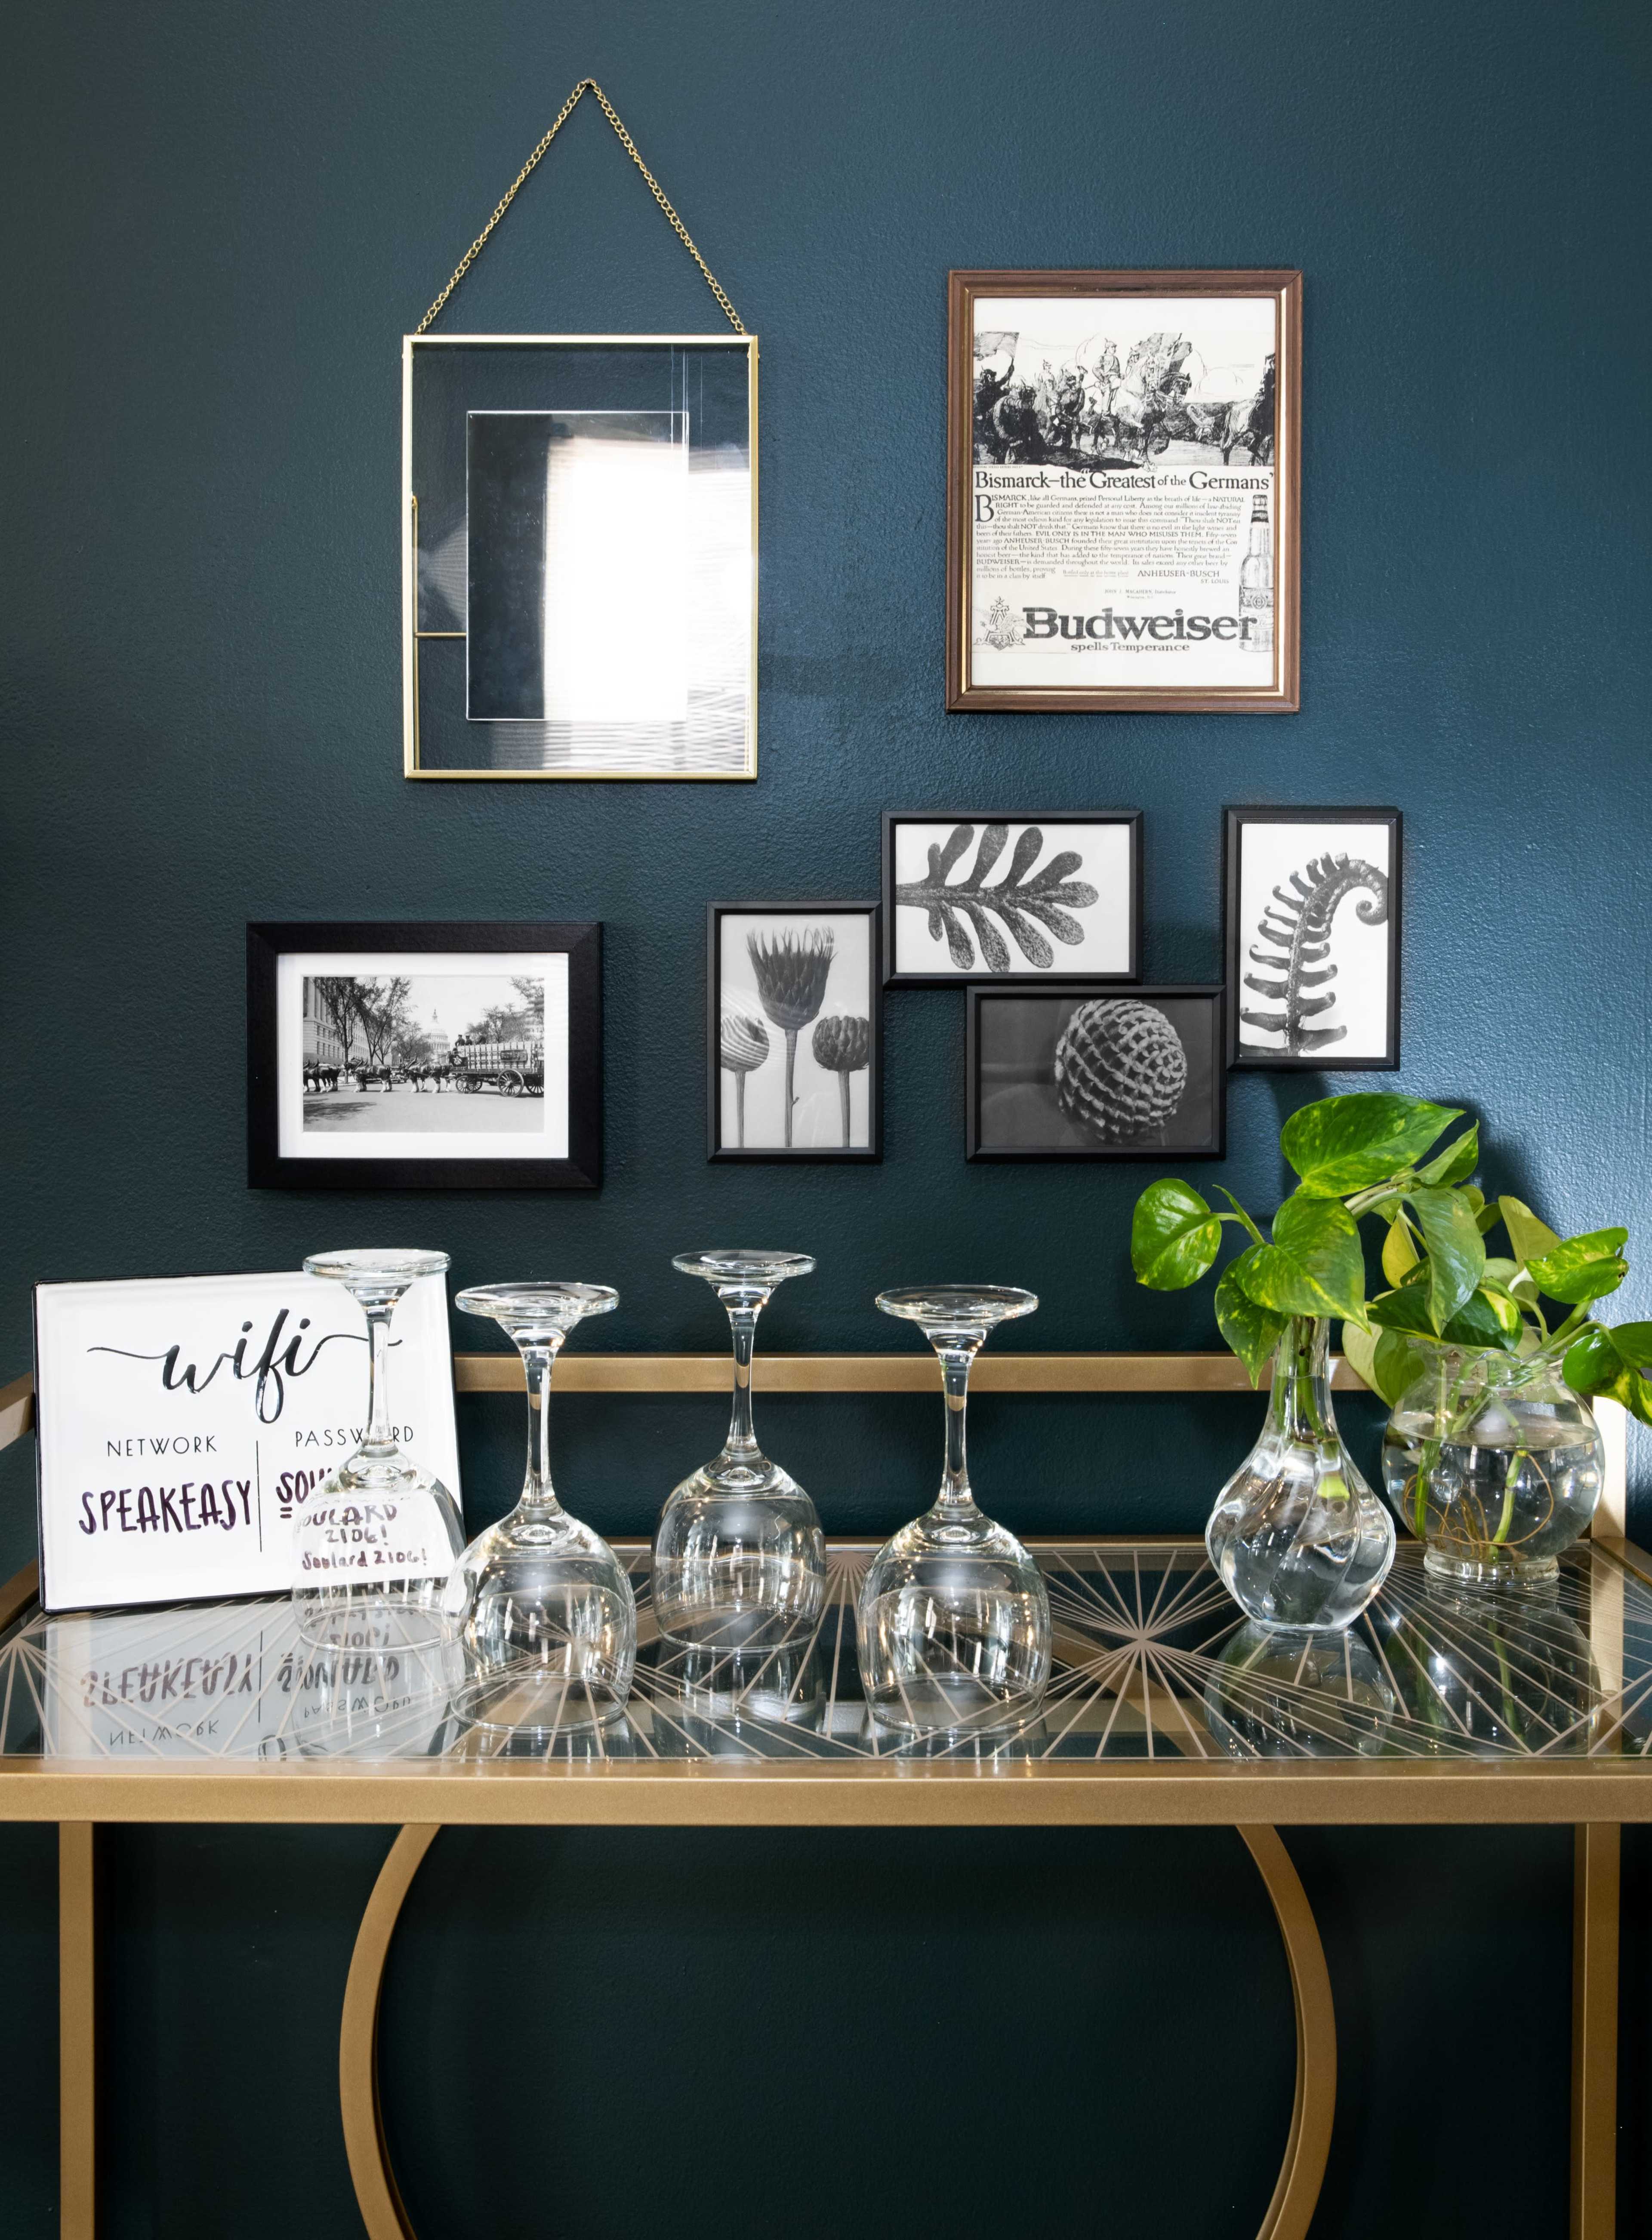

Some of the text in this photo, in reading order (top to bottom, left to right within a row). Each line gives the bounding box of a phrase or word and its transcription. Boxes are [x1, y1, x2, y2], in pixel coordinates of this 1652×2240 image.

[1157, 475, 1169, 486] of
[1170, 475, 1186, 485] the
[1023, 607, 1257, 641] Budweiser
[1071, 642, 1190, 653] spells Temperance
[107, 1435, 217, 1457] NETWORK
[295, 1426, 413, 1448] PASSWRD
[78, 1479, 251, 1535] SPEAKEASY
